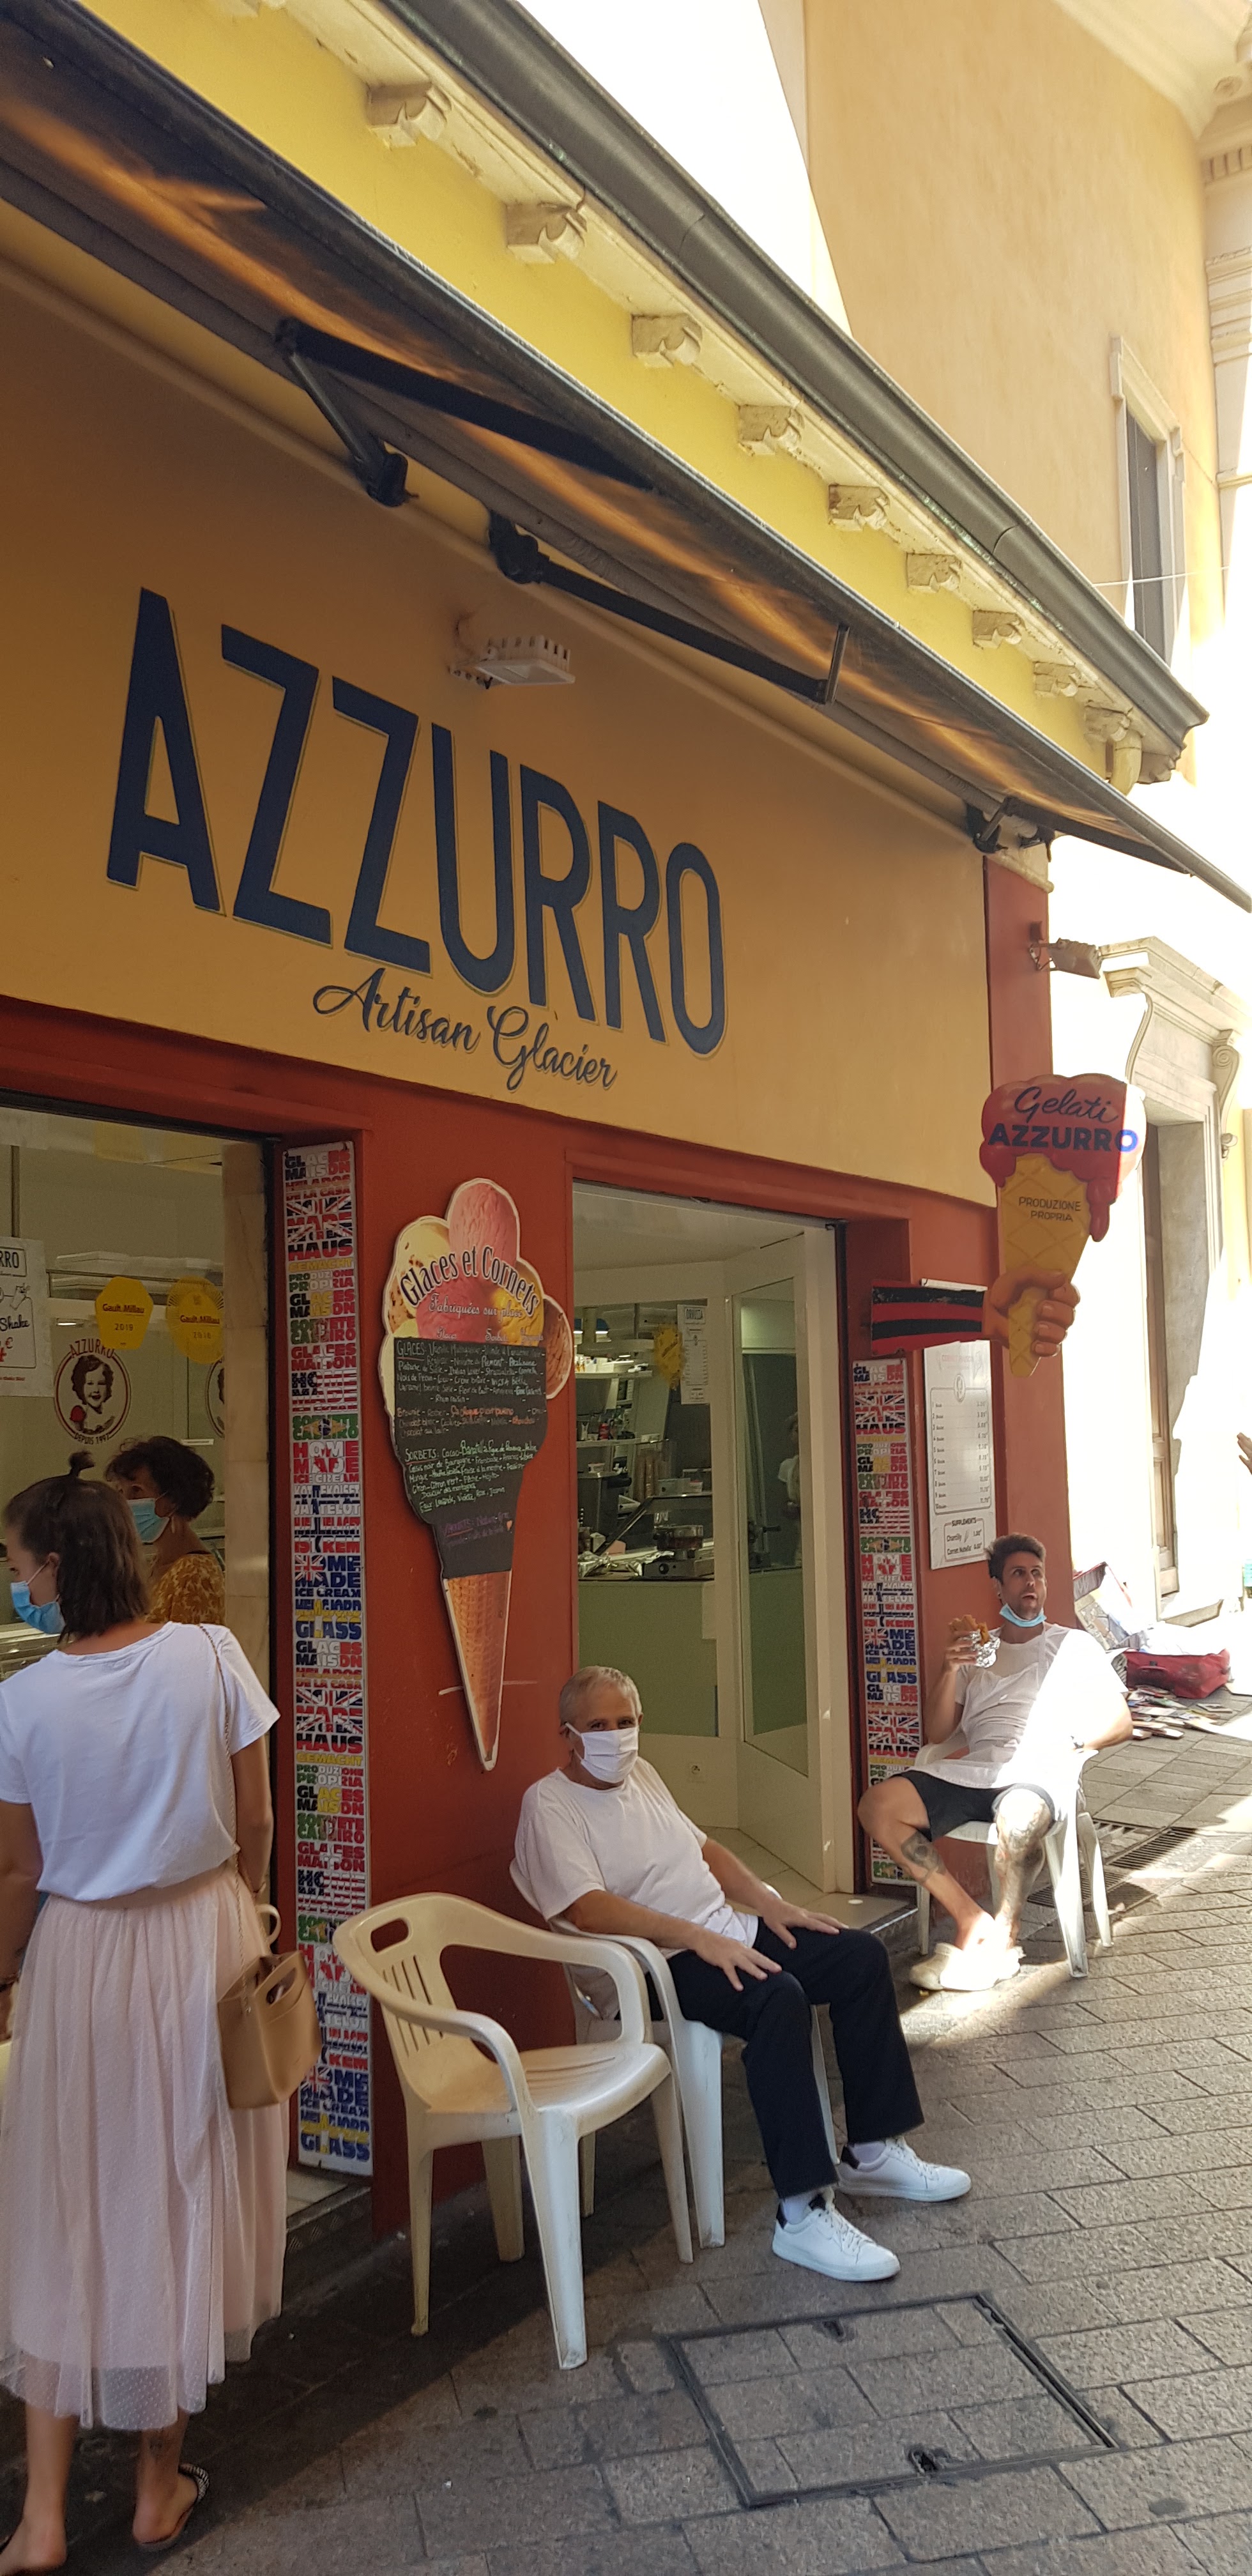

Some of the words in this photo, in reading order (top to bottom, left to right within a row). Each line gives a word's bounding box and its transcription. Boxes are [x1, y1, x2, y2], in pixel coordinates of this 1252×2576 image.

[107, 587, 727, 1059] AZZURRO
[313, 967, 478, 1051] Artisan
[487, 1006, 617, 1090] Glacier
[1014, 1086, 1118, 1123] Gelati
[988, 1123, 1138, 1152] AZZURRO
[285, 1151, 350, 1169] GLACES
[286, 1161, 350, 1181] MAISON
[1018, 1196, 1081, 1211] PRODUZIONE
[1030, 1210, 1073, 1222] PROPRIA
[288, 1239, 353, 1261] HAUS
[289, 1278, 353, 1292] PROPRIA
[401, 1253, 458, 1307] Glaces
[462, 1246, 478, 1276] et
[483, 1246, 539, 1316] Cornets
[290, 1289, 355, 1306] GLACES
[429, 1292, 480, 1319] Fabriquées
[290, 1302, 355, 1318] MAISON
[291, 1343, 356, 1359] GLACES
[291, 1356, 356, 1372] MAISON
[856, 1422, 906, 1435] HAUS
[293, 1441, 359, 1458] HOME
[293, 1457, 359, 1474] MADE
[294, 1555, 360, 1572] HOME
[861, 1554, 912, 1565] HOME
[862, 1564, 912, 1575] MADE
[294, 1572, 360, 1588] MADE
[295, 1588, 314, 1597] ICE
[317, 1588, 361, 1597] CREAM
[296, 1616, 362, 1639] GLASS
[296, 1641, 362, 1655] GLACES
[865, 1639, 915, 1650] MADE
[296, 1653, 362, 1667] MAISON
[867, 1668, 917, 1683] GLASS
[296, 1733, 363, 1753] HAUS
[869, 1744, 919, 1758] HAUS
[296, 1773, 363, 1788] PROPRIA
[297, 1786, 363, 1802] GLACES
[297, 1798, 364, 1815] MAISON
[298, 1841, 365, 1859] GLACES
